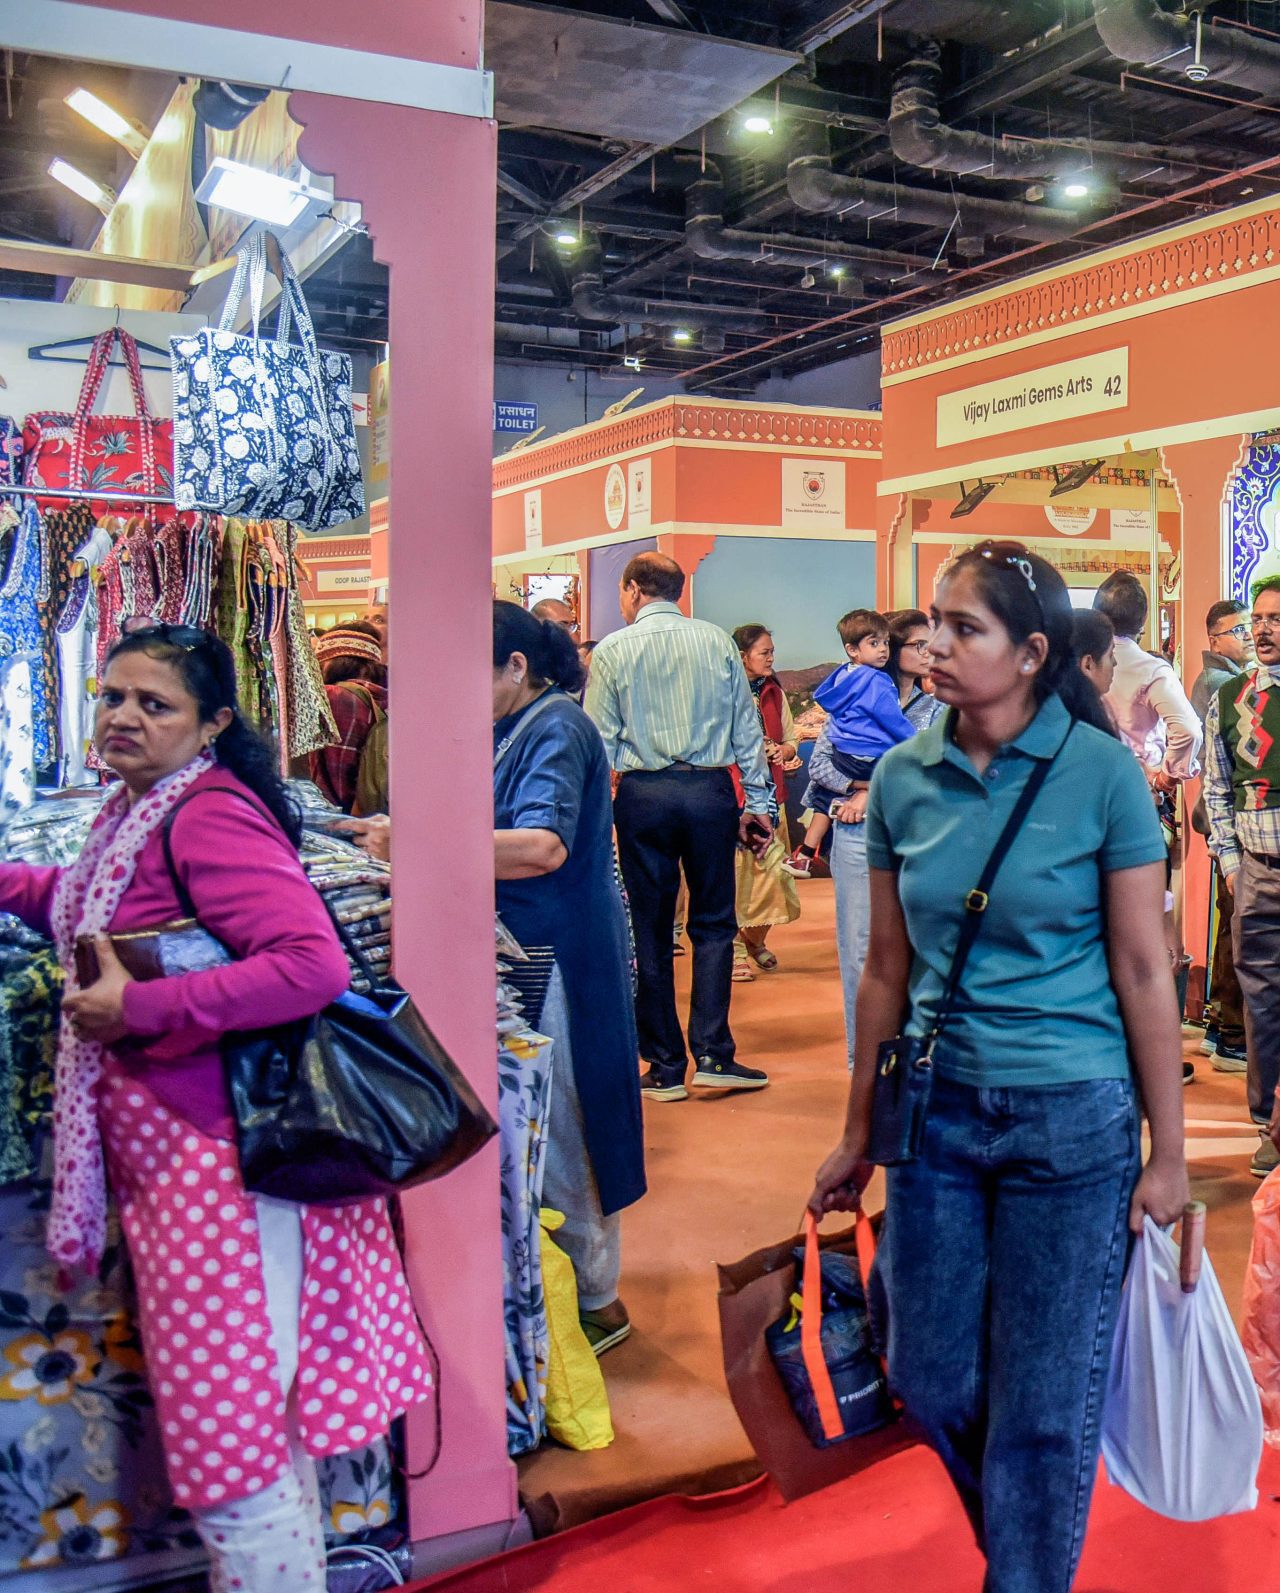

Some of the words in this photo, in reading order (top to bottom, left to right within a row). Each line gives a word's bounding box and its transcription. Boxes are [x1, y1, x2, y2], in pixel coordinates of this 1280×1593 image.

[1103, 374, 1122, 397] 42
[963, 402, 991, 425] Vijay
[992, 388, 1026, 415] Laxmi
[1028, 384, 1064, 406] Gems
[1065, 375, 1093, 397] Arts
[498, 405, 536, 418] प्रसाधन
[498, 418, 536, 430] TOILET
